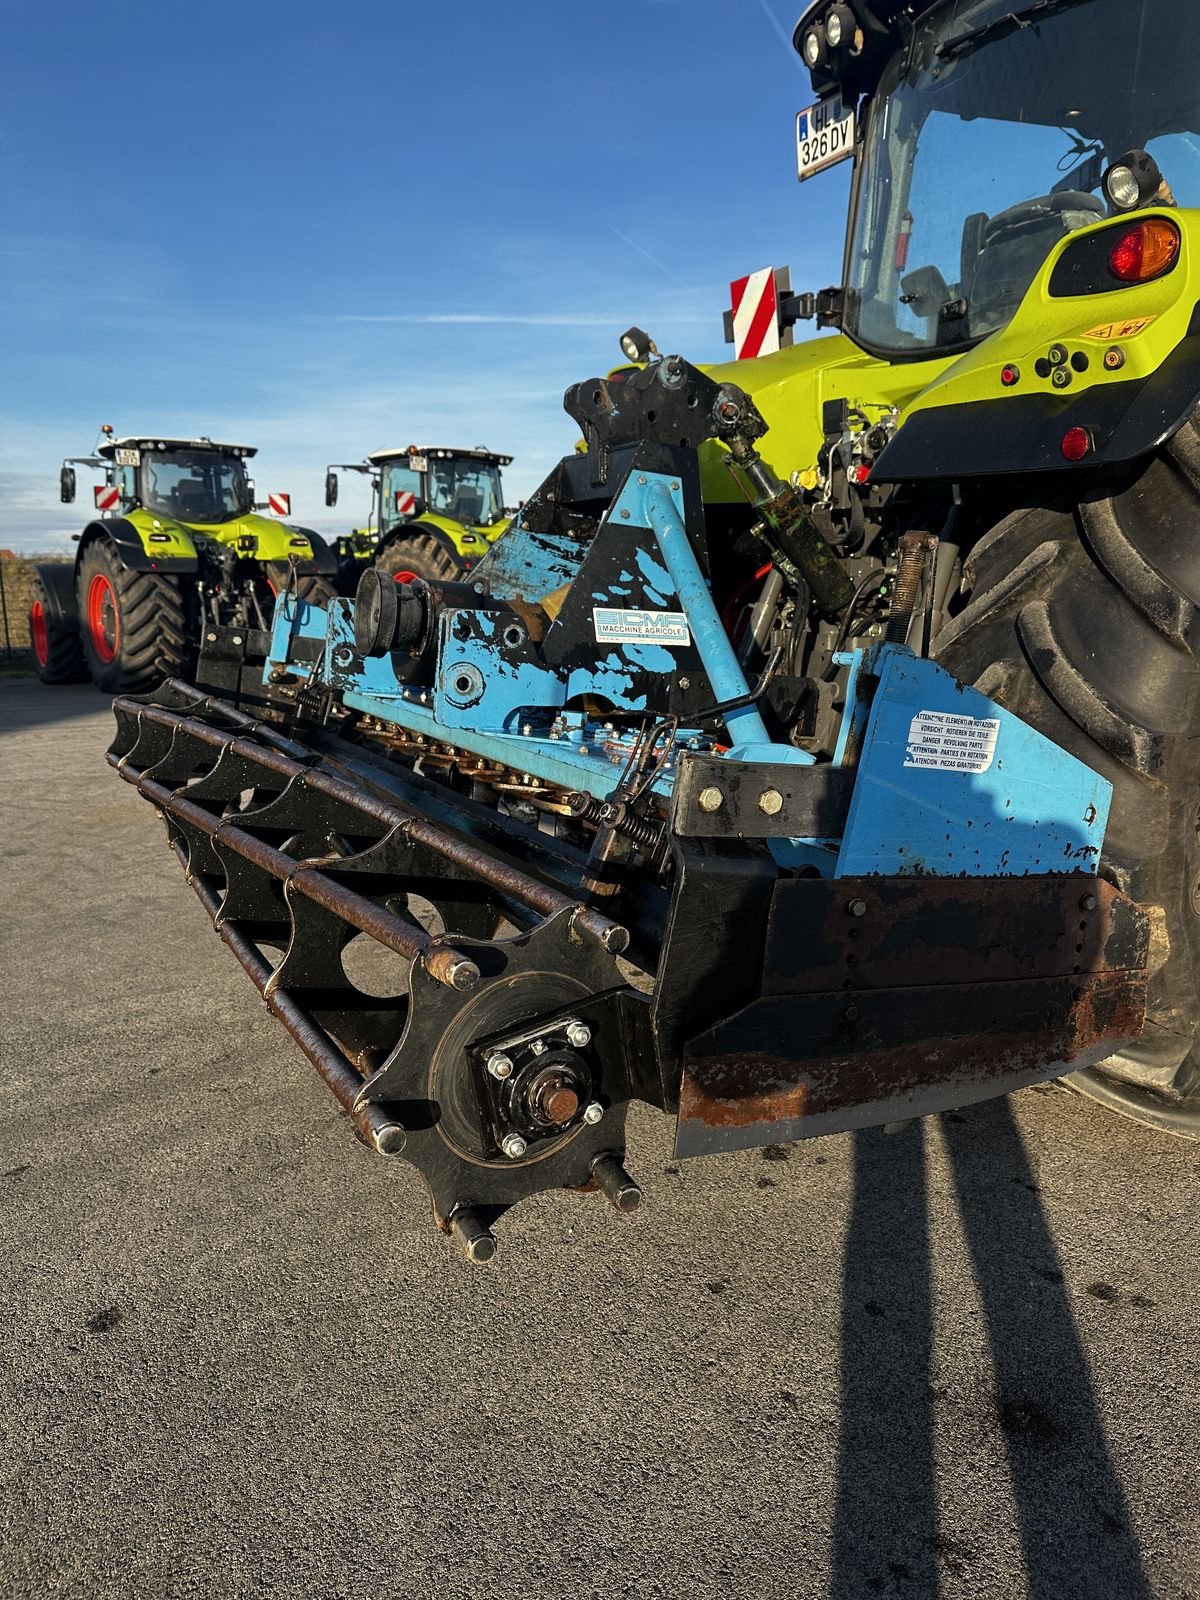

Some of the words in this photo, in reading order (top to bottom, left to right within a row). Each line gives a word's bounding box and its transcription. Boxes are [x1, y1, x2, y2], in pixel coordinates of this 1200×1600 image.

[815, 105, 831, 133] HL
[802, 132, 828, 165] 326
[831, 120, 848, 151] DV
[595, 610, 687, 628] SICMA
[602, 624, 643, 634] MACCHINE
[645, 627, 682, 636] AGRICOLE
[946, 717, 968, 726] ELEMENTI
[968, 719, 973, 727] IN
[974, 720, 997, 729] ROTAZIONE
[921, 725, 943, 733] VORSICHT
[946, 728, 967, 736] ROTIEREN
[968, 730, 976, 738] DIE
[976, 731, 989, 739] TEILE
[922, 735, 941, 744] DANGER
[943, 738, 968, 748] REVOLVING
[968, 741, 983, 749] PARTS
[913, 746, 938, 754] ATTENTION
[940, 748, 959, 757] PARTIES
[959, 750, 966, 758] EN
[968, 752, 988, 760] ROTATION
[940, 759, 956, 768] PIEZAS
[956, 761, 982, 770] GIRATORIAS
